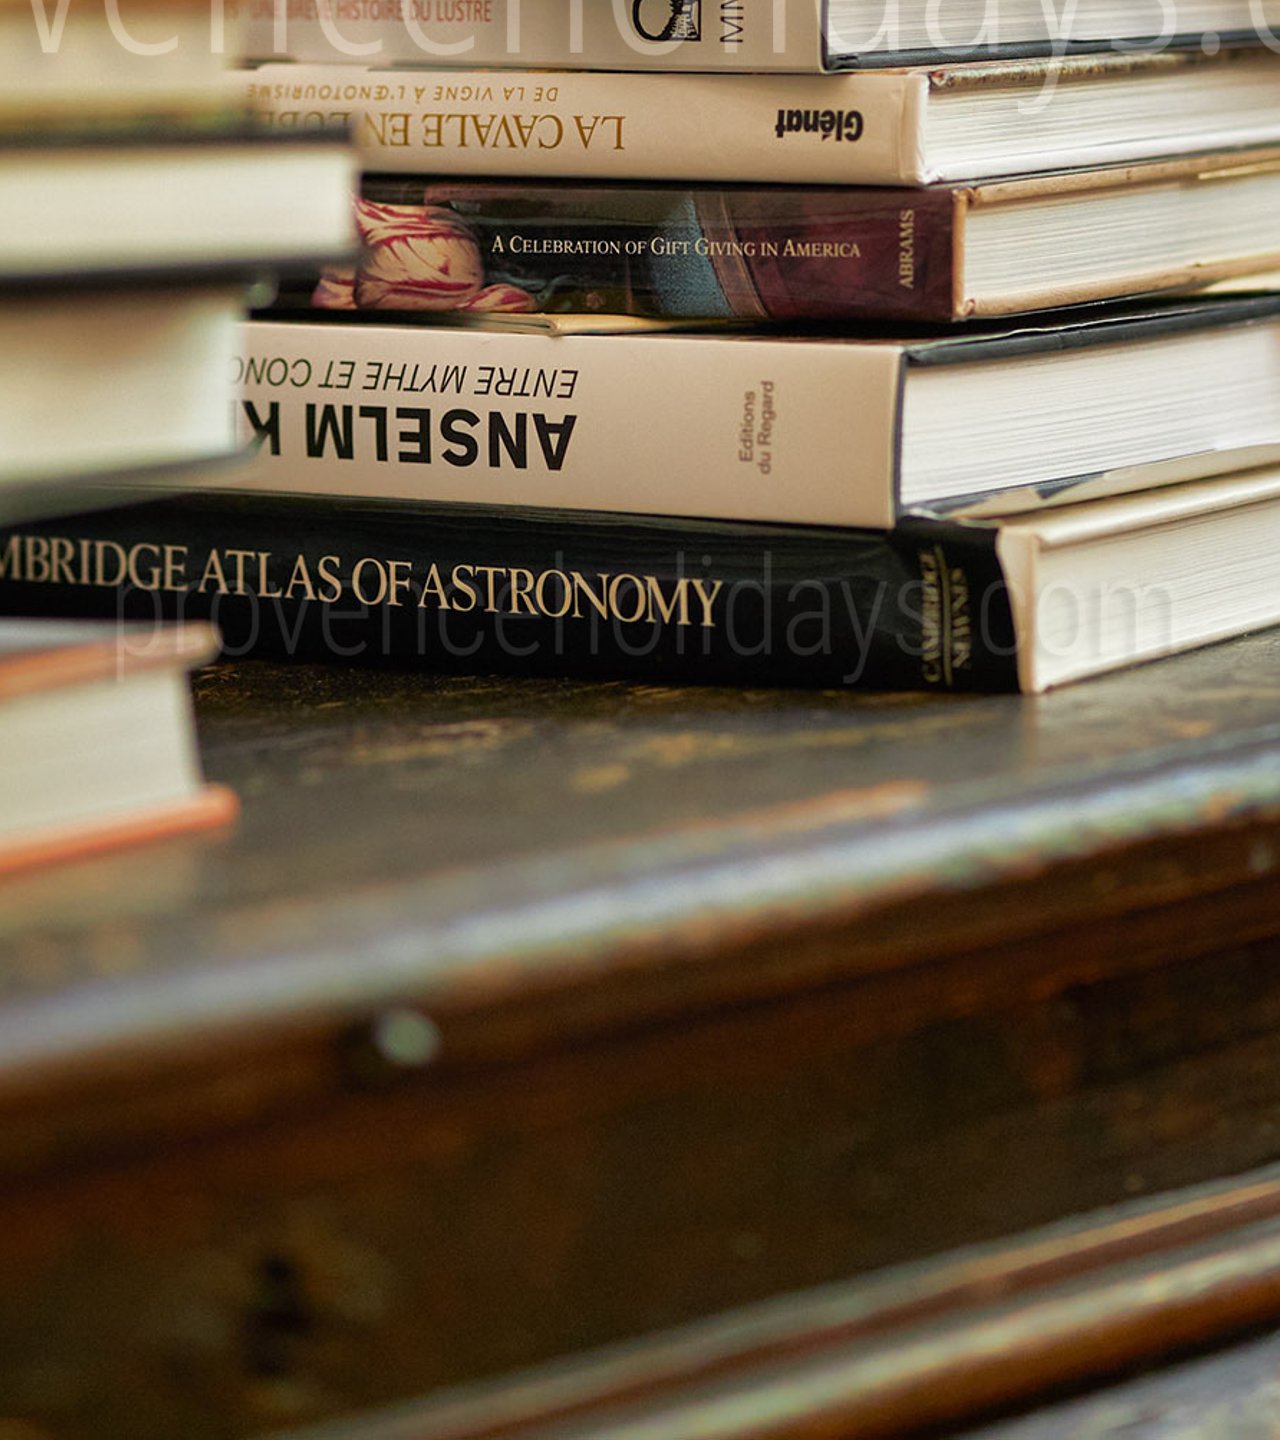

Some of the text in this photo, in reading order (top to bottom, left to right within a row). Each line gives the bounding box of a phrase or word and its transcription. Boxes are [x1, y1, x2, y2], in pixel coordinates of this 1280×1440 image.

[435, 0, 492, 23] LUSTRE
[414, 85, 426, 104] À
[433, 84, 493, 102] VIGNE
[503, 86, 525, 102] LA
[534, 86, 559, 102] DE
[363, 112, 412, 147] EN
[422, 113, 564, 149] CAVALE
[573, 114, 626, 150] LA
[775, 109, 864, 142] Glénat
[491, 236, 504, 254] A
[509, 235, 620, 255] CELEBRATION
[650, 237, 690, 256] GIFT
[694, 238, 756, 257] GIVING
[782, 238, 861, 258] AMERICA
[898, 209, 916, 290] ABRAMS
[317, 360, 356, 389] ET
[362, 361, 468, 394] MYTHE
[473, 366, 579, 398] ENTRE
[231, 399, 578, 471] ANSELM K
[738, 390, 757, 463] Editions
[757, 380, 777, 476] du Regard
[197, 547, 343, 605] ATLAS
[351, 556, 413, 607] OF
[417, 562, 723, 628] ASTRONOMY
